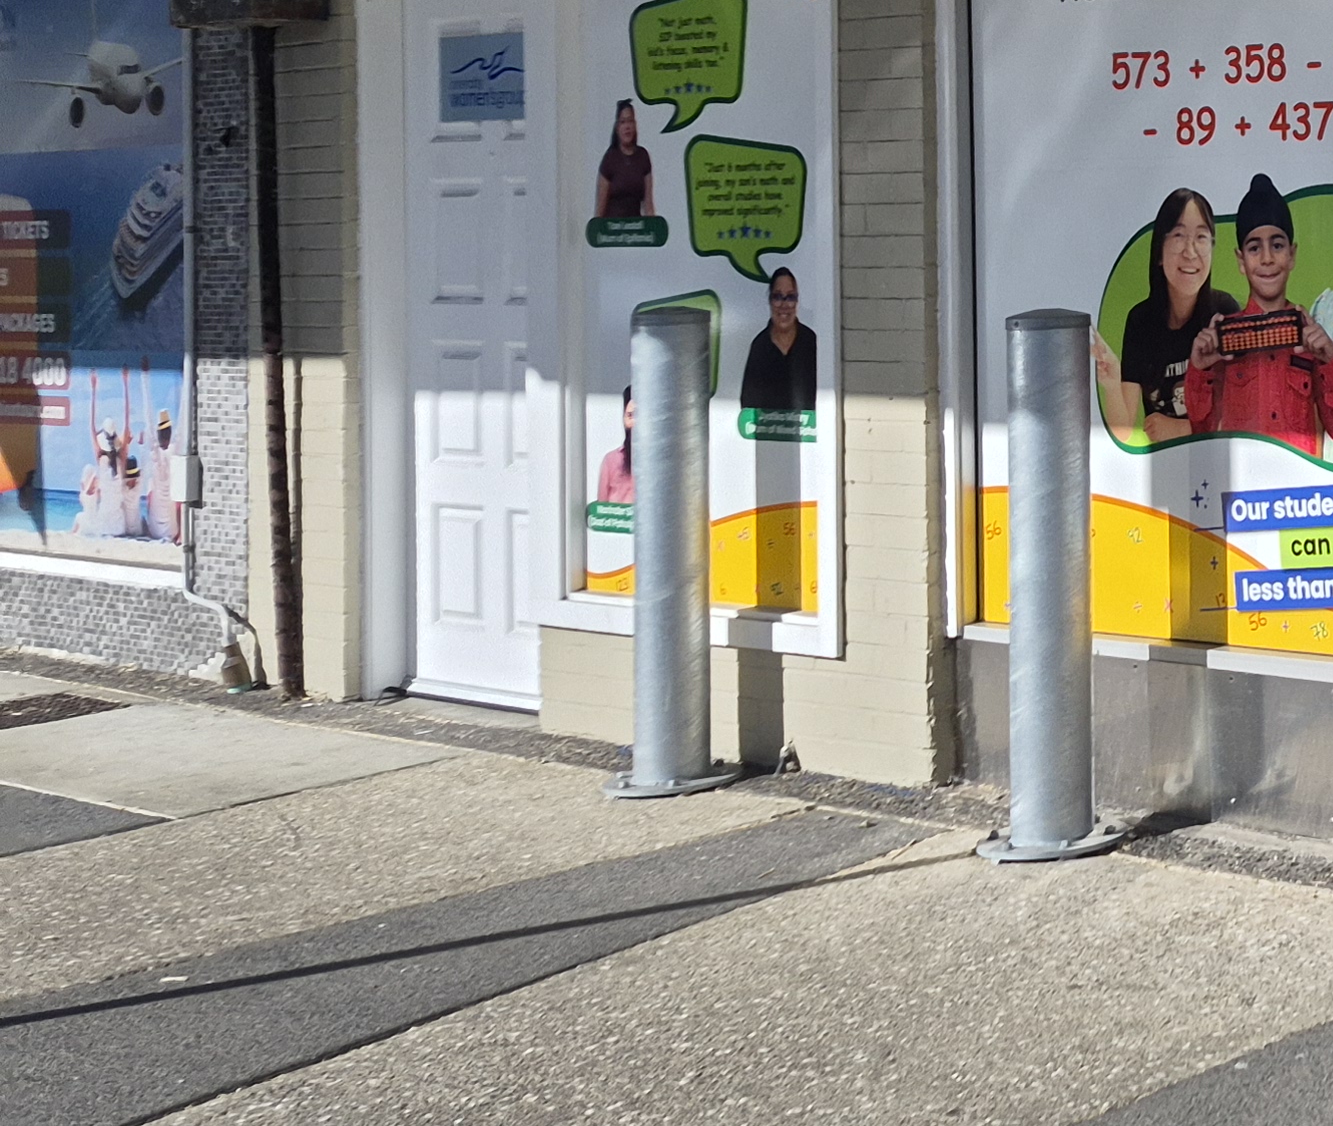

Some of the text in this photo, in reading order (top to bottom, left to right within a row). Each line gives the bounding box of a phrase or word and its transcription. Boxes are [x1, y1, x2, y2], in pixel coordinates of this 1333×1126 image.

[1111, 49, 1172, 90] 573
[1188, 59, 1207, 80] +
[1224, 42, 1287, 85] 358
[1175, 105, 1216, 146] 89
[1234, 116, 1252, 138] +
[1231, 498, 1269, 522] Our
[1291, 534, 1330, 557] can
[1242, 578, 1284, 602] less
[1248, 612, 1268, 632] 56
